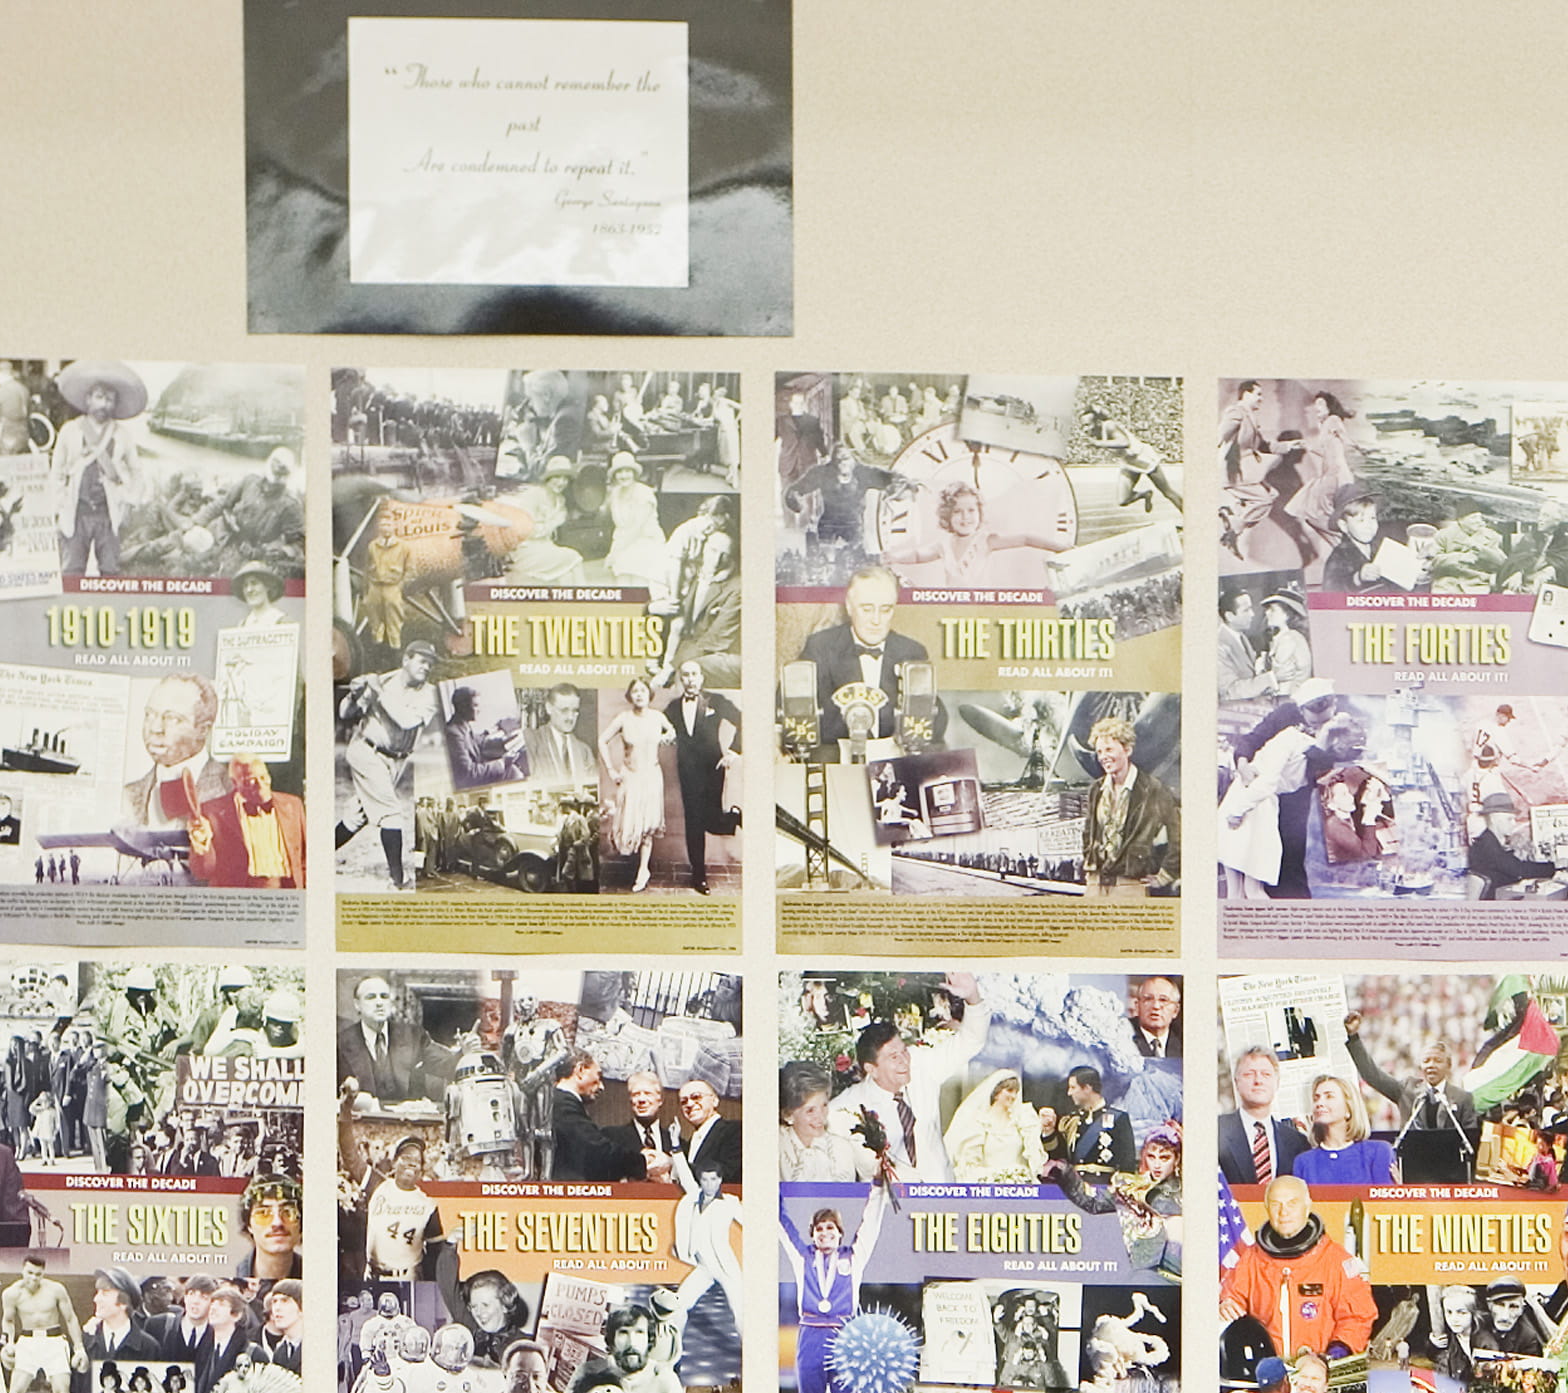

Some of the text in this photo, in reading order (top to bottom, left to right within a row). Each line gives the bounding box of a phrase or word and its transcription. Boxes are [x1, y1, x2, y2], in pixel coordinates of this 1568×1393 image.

[496, 74, 549, 91] cannot
[554, 70, 631, 92] remember
[636, 72, 660, 93] the
[506, 116, 541, 137] past
[451, 151, 537, 175] condemned
[543, 157, 559, 175] to
[490, 588, 622, 600] DISCOVER THE DECADE
[46, 605, 196, 648] 1910-1919
[470, 615, 663, 658] THE TWENTIES
[941, 617, 1115, 661] THE THIRTIES
[1347, 623, 1512, 665] THE FORTIES
[998, 667, 1113, 678] READ ALL ABOUT IT!
[189, 1056, 305, 1081] WE SHALL
[182, 1078, 305, 1107] OVERCOM
[70, 1204, 229, 1247] THE SIXTIES
[387, 1221, 415, 1245] 44
[458, 1211, 659, 1254] THE SEVENTIES
[910, 1212, 1082, 1254] THE EIGHTIES
[1374, 1214, 1553, 1255] THE NINETIES
[554, 1284, 608, 1305] PUMPS
[549, 1305, 603, 1326] CLOSED
